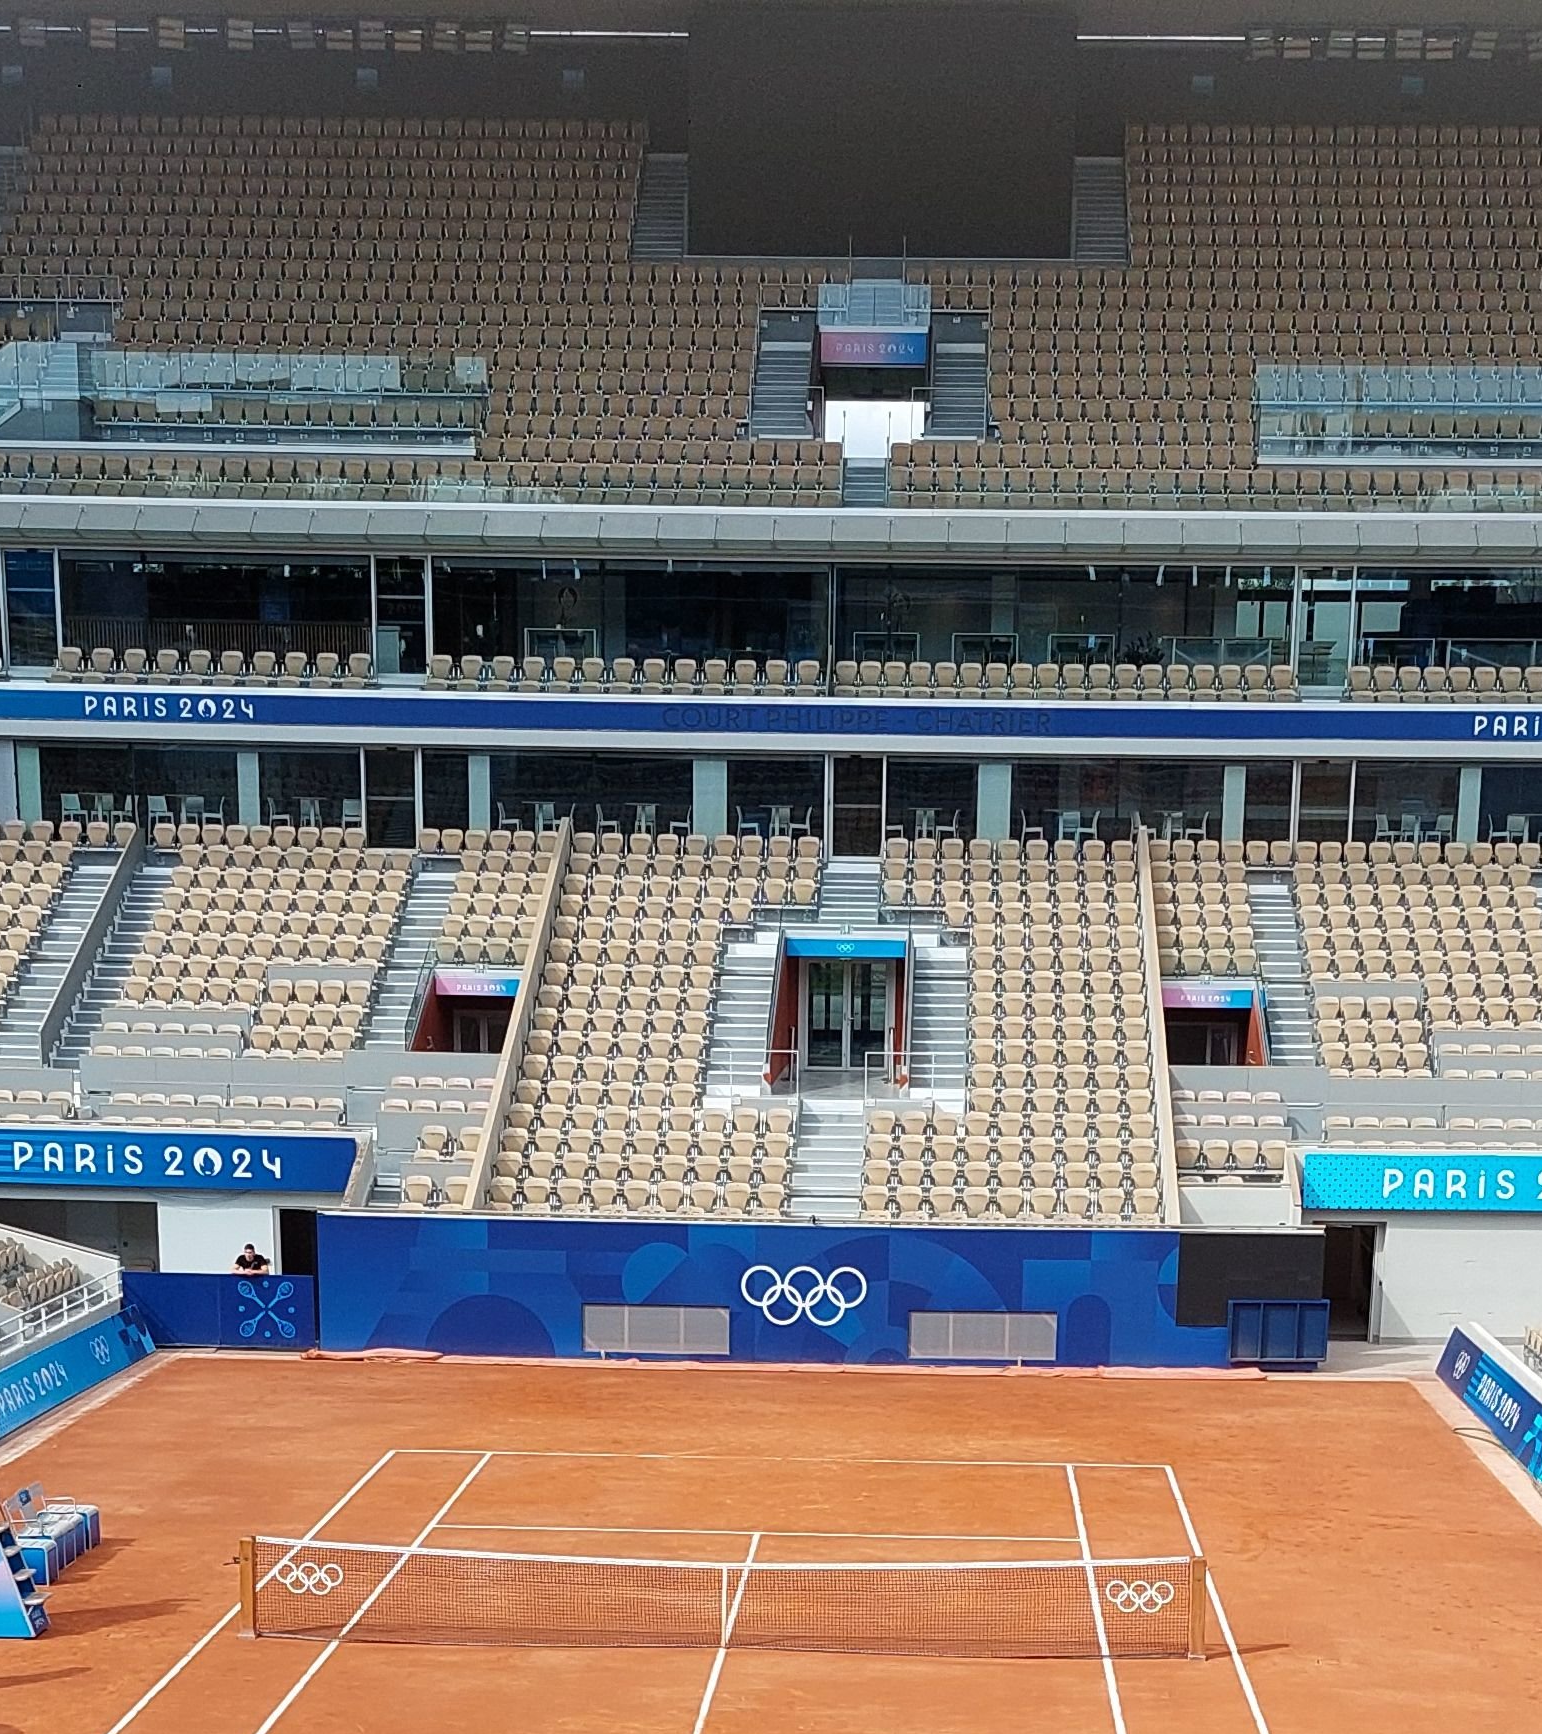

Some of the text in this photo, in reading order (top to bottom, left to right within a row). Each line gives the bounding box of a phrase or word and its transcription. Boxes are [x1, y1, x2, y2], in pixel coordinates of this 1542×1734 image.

[84, 695, 254, 719] PARIS 2024
[662, 706, 757, 729] COURT
[766, 708, 889, 732] PHILIPPE
[915, 709, 1052, 734] CHATRIER
[13, 1141, 282, 1179] PARIS 2024
[1382, 1168, 1516, 1200] PARIS
[32, 1360, 68, 1396] 2024
[1474, 1373, 1522, 1432] PARIS 2024
